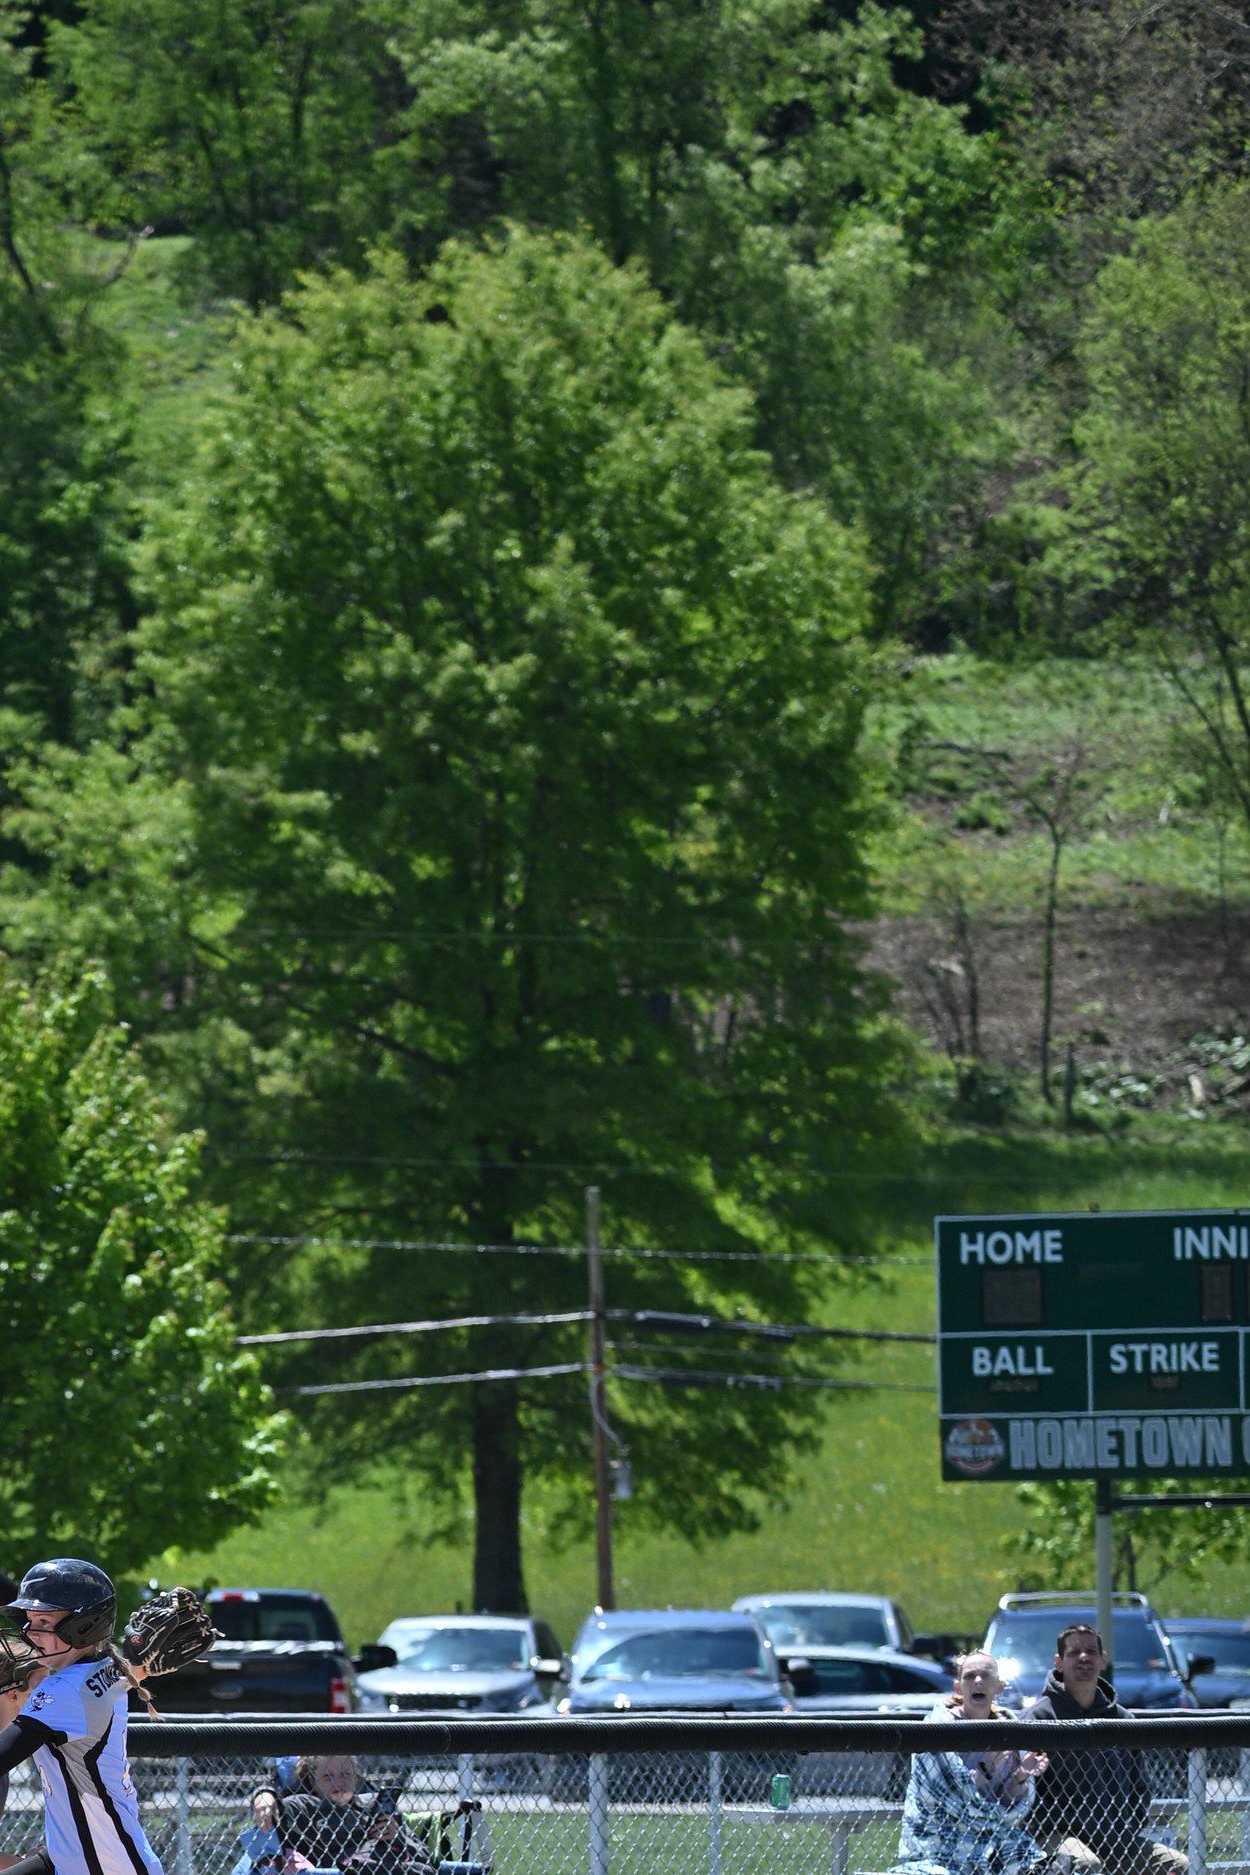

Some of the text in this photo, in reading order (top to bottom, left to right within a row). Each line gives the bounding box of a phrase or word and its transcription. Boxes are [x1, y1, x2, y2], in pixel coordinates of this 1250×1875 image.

[959, 1230, 1063, 1264] HOME
[972, 1346, 1054, 1376] BALL
[1110, 1343, 1220, 1373] STRIKE
[1009, 1417, 1232, 1469] HOMETOWN
